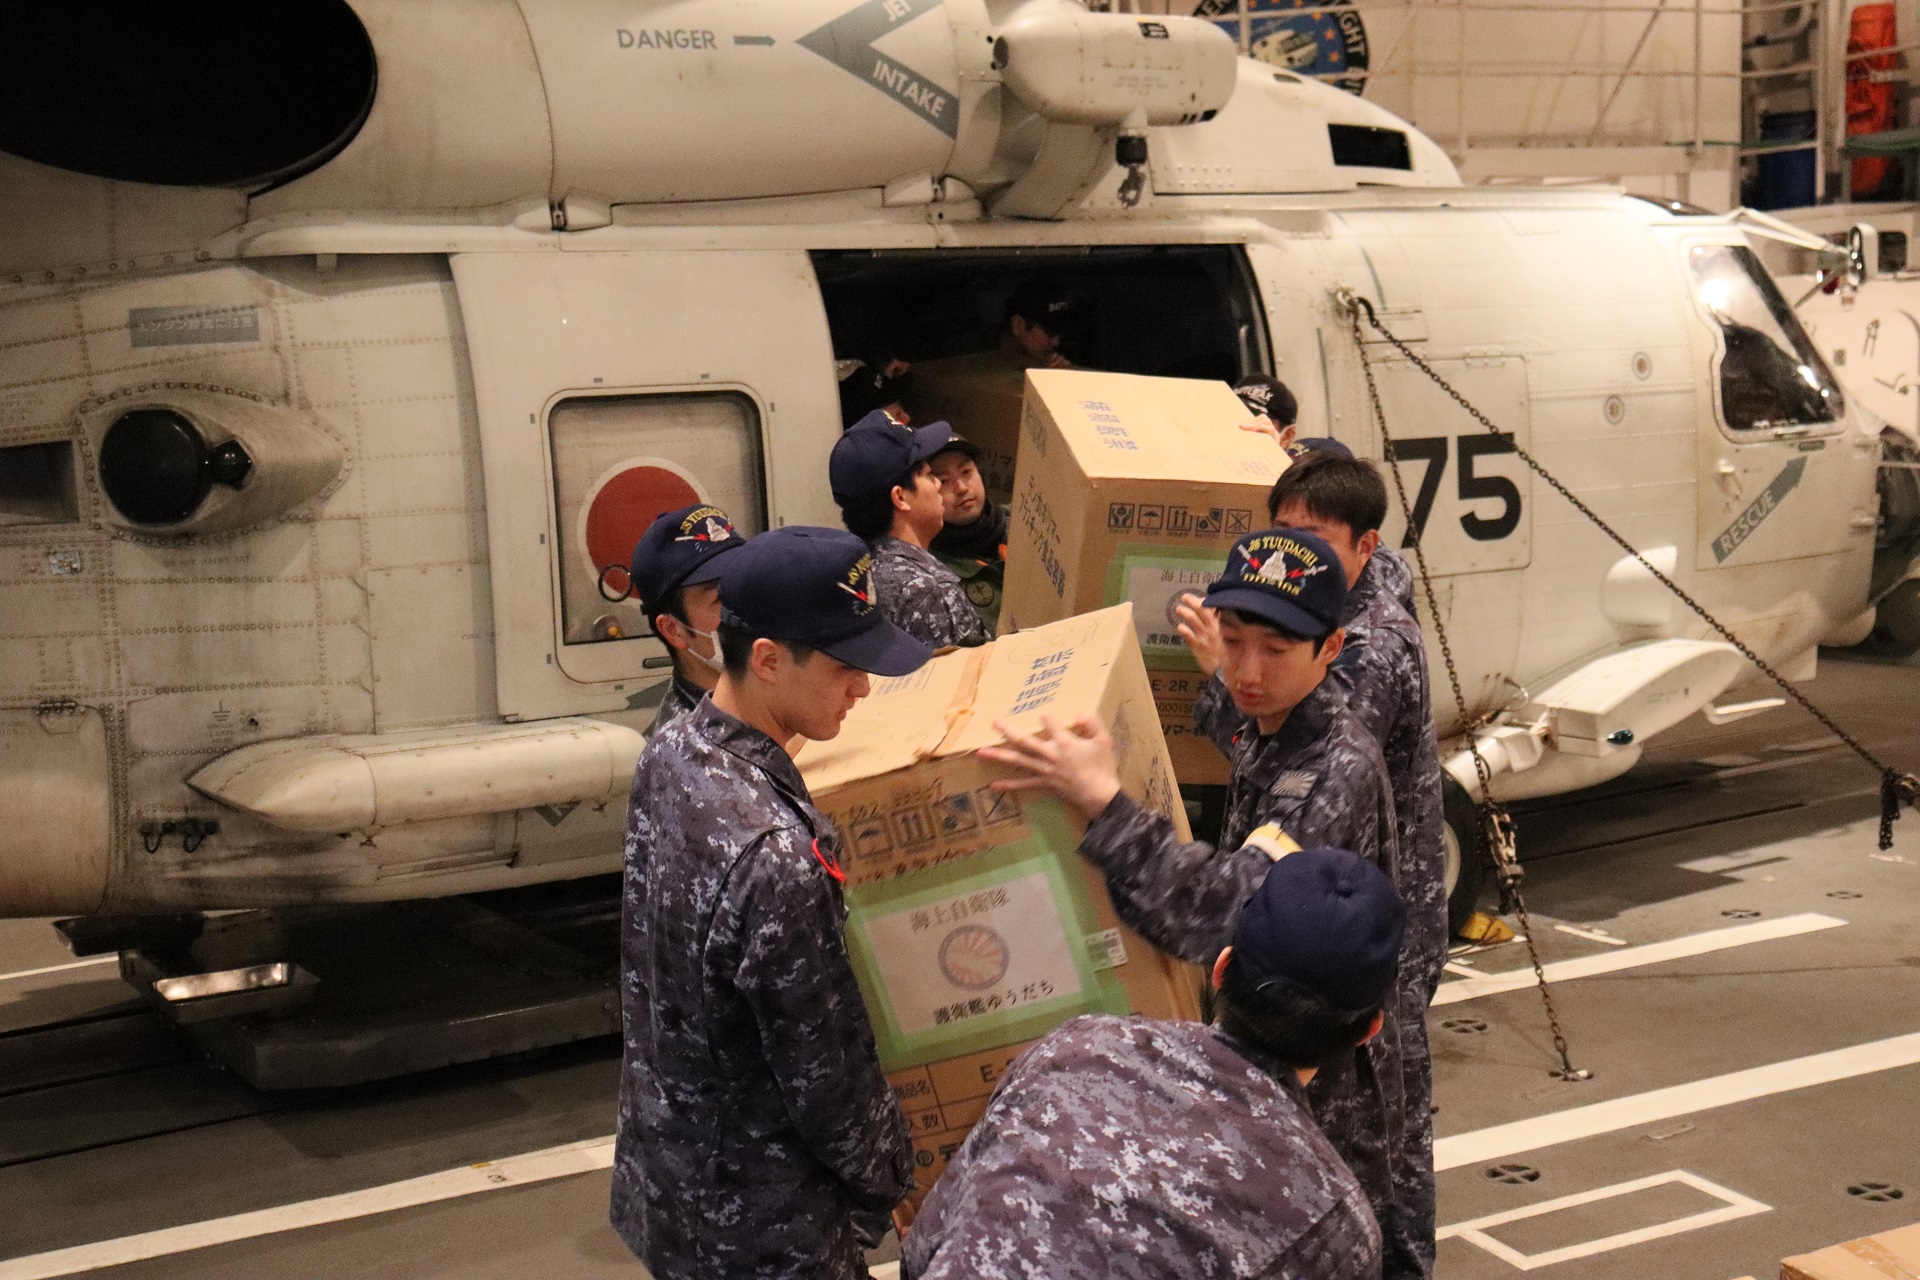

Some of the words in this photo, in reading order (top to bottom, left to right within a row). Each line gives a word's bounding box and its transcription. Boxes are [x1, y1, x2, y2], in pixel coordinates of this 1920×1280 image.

[882, 0, 912, 22] JET
[617, 29, 717, 50] DANGER
[873, 59, 945, 119] INTAKE
[1384, 432, 1522, 550] 75
[1720, 490, 1776, 554] RESCUE
[1262, 536, 1319, 567] YUUDACHI
[1146, 632, 1188, 646] 護衛艦
[933, 979, 1054, 1026] 護衛艦ゆうだち
